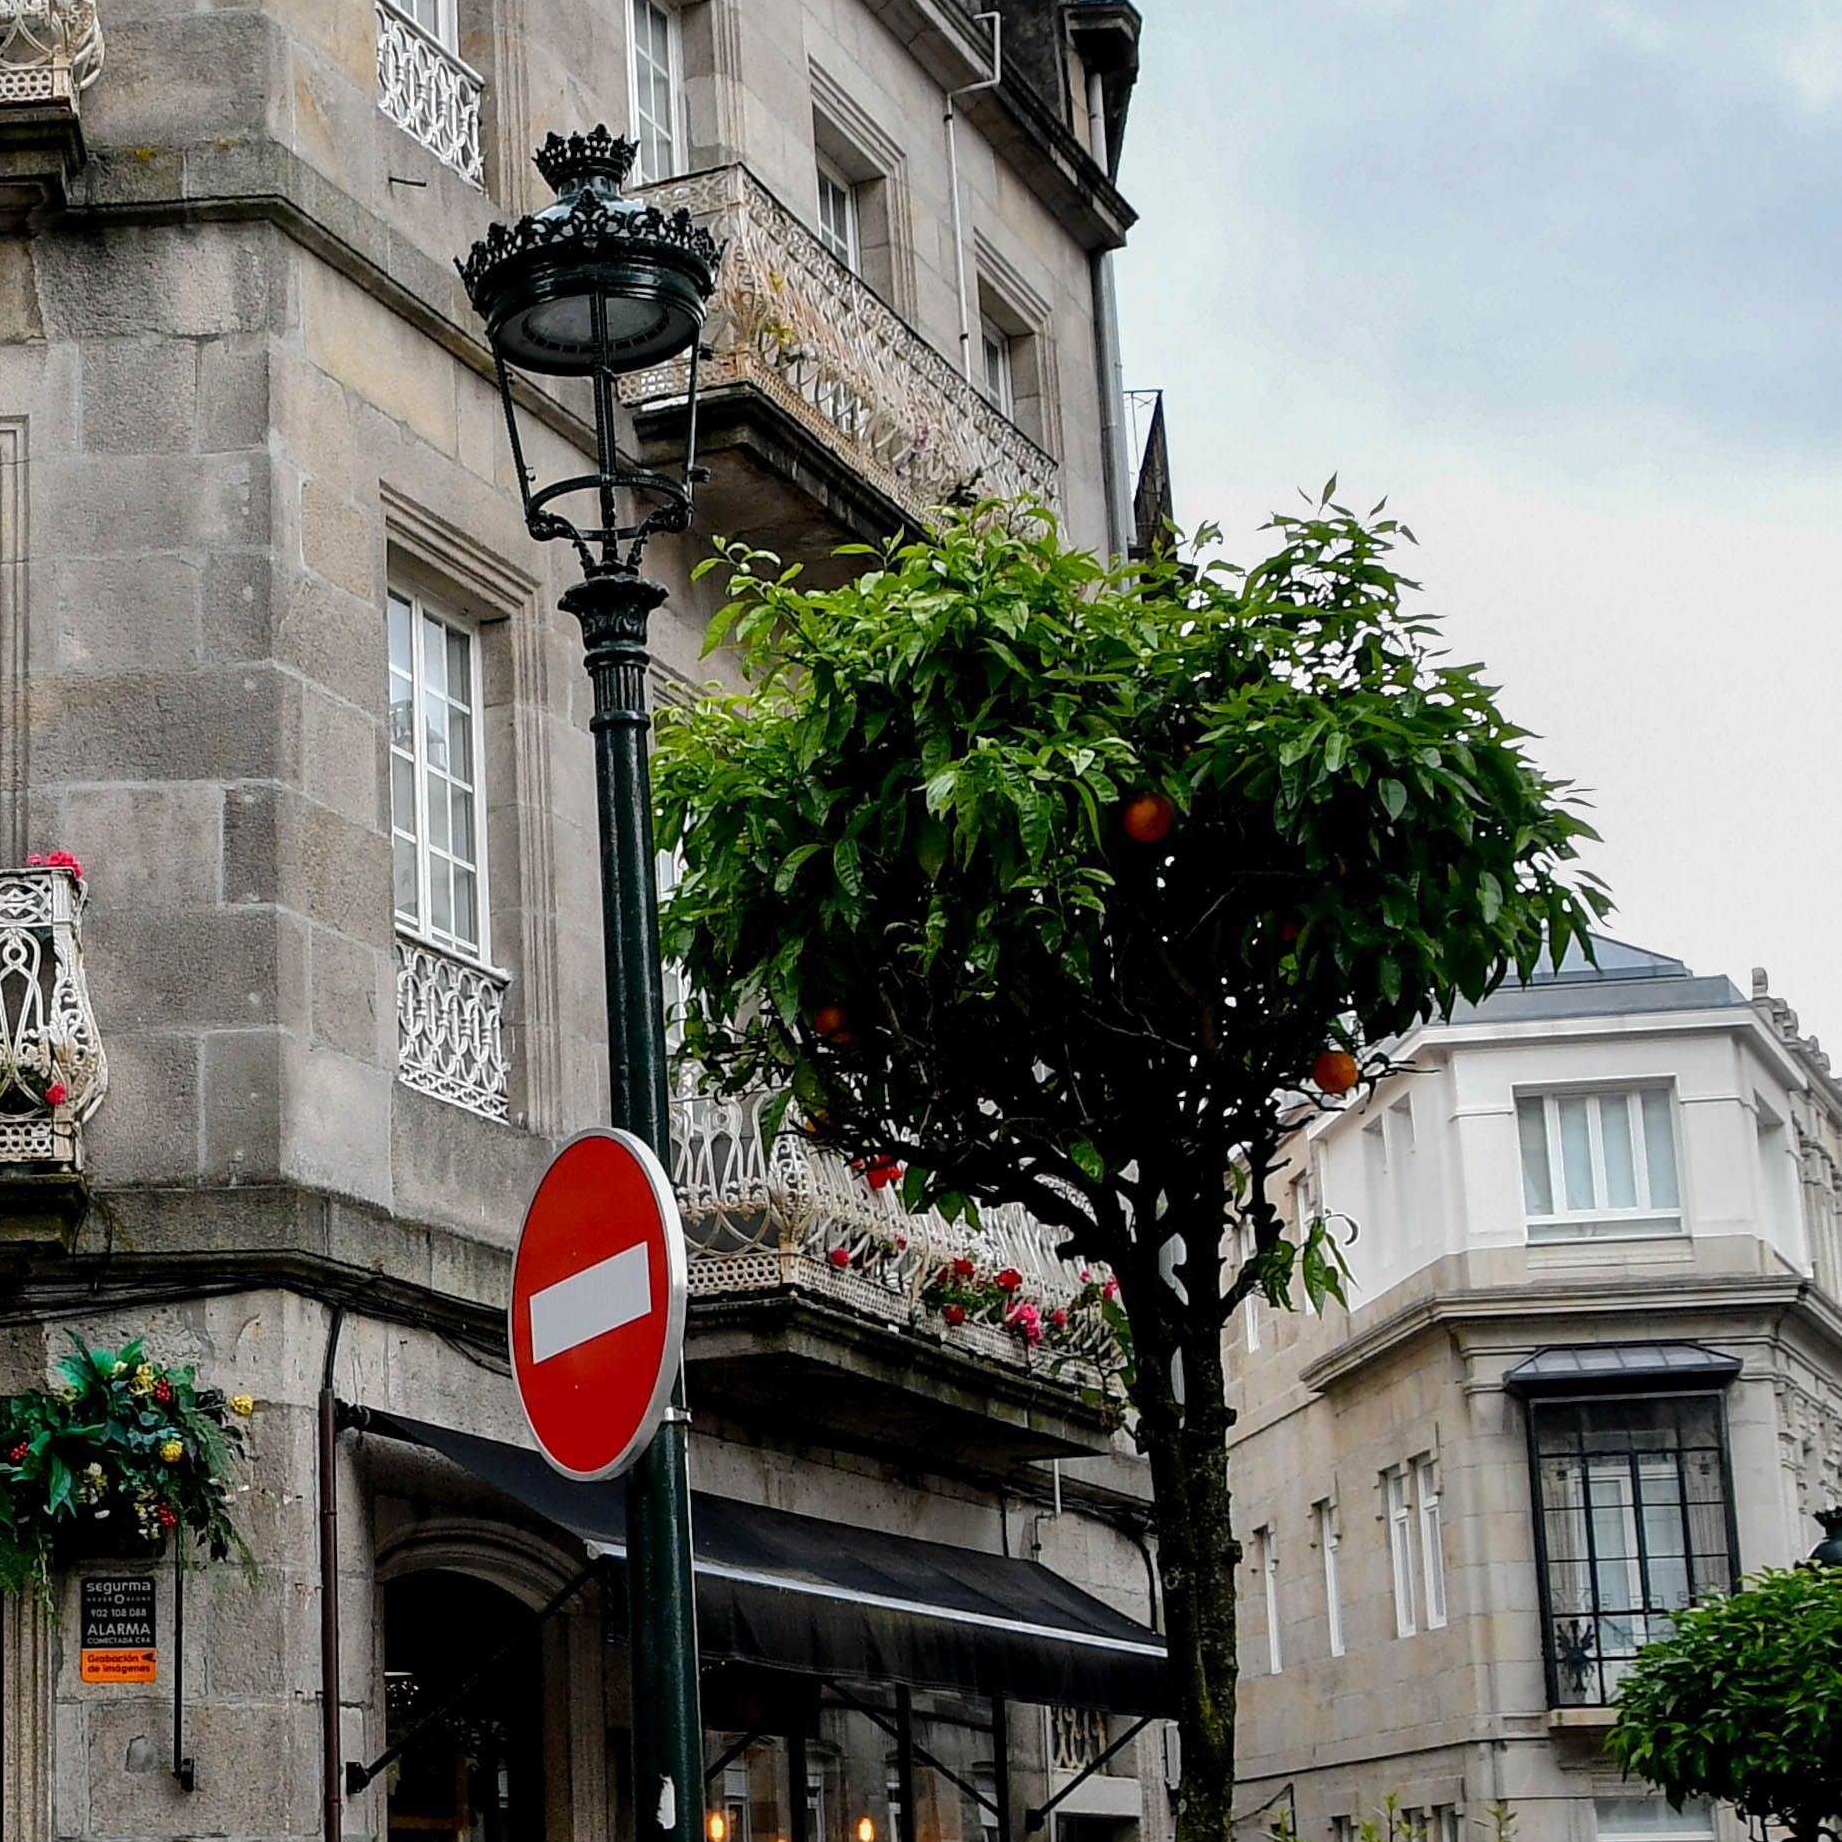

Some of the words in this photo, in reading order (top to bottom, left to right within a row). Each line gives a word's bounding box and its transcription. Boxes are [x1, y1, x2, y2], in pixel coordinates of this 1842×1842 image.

[86, 1581, 151, 1595] segurma
[87, 1623, 151, 1636] ALARMA
[87, 1637, 133, 1645] CONECTADA
[87, 1653, 139, 1663] Grabación
[87, 1665, 100, 1673] de
[102, 1664, 151, 1674] imágenes
